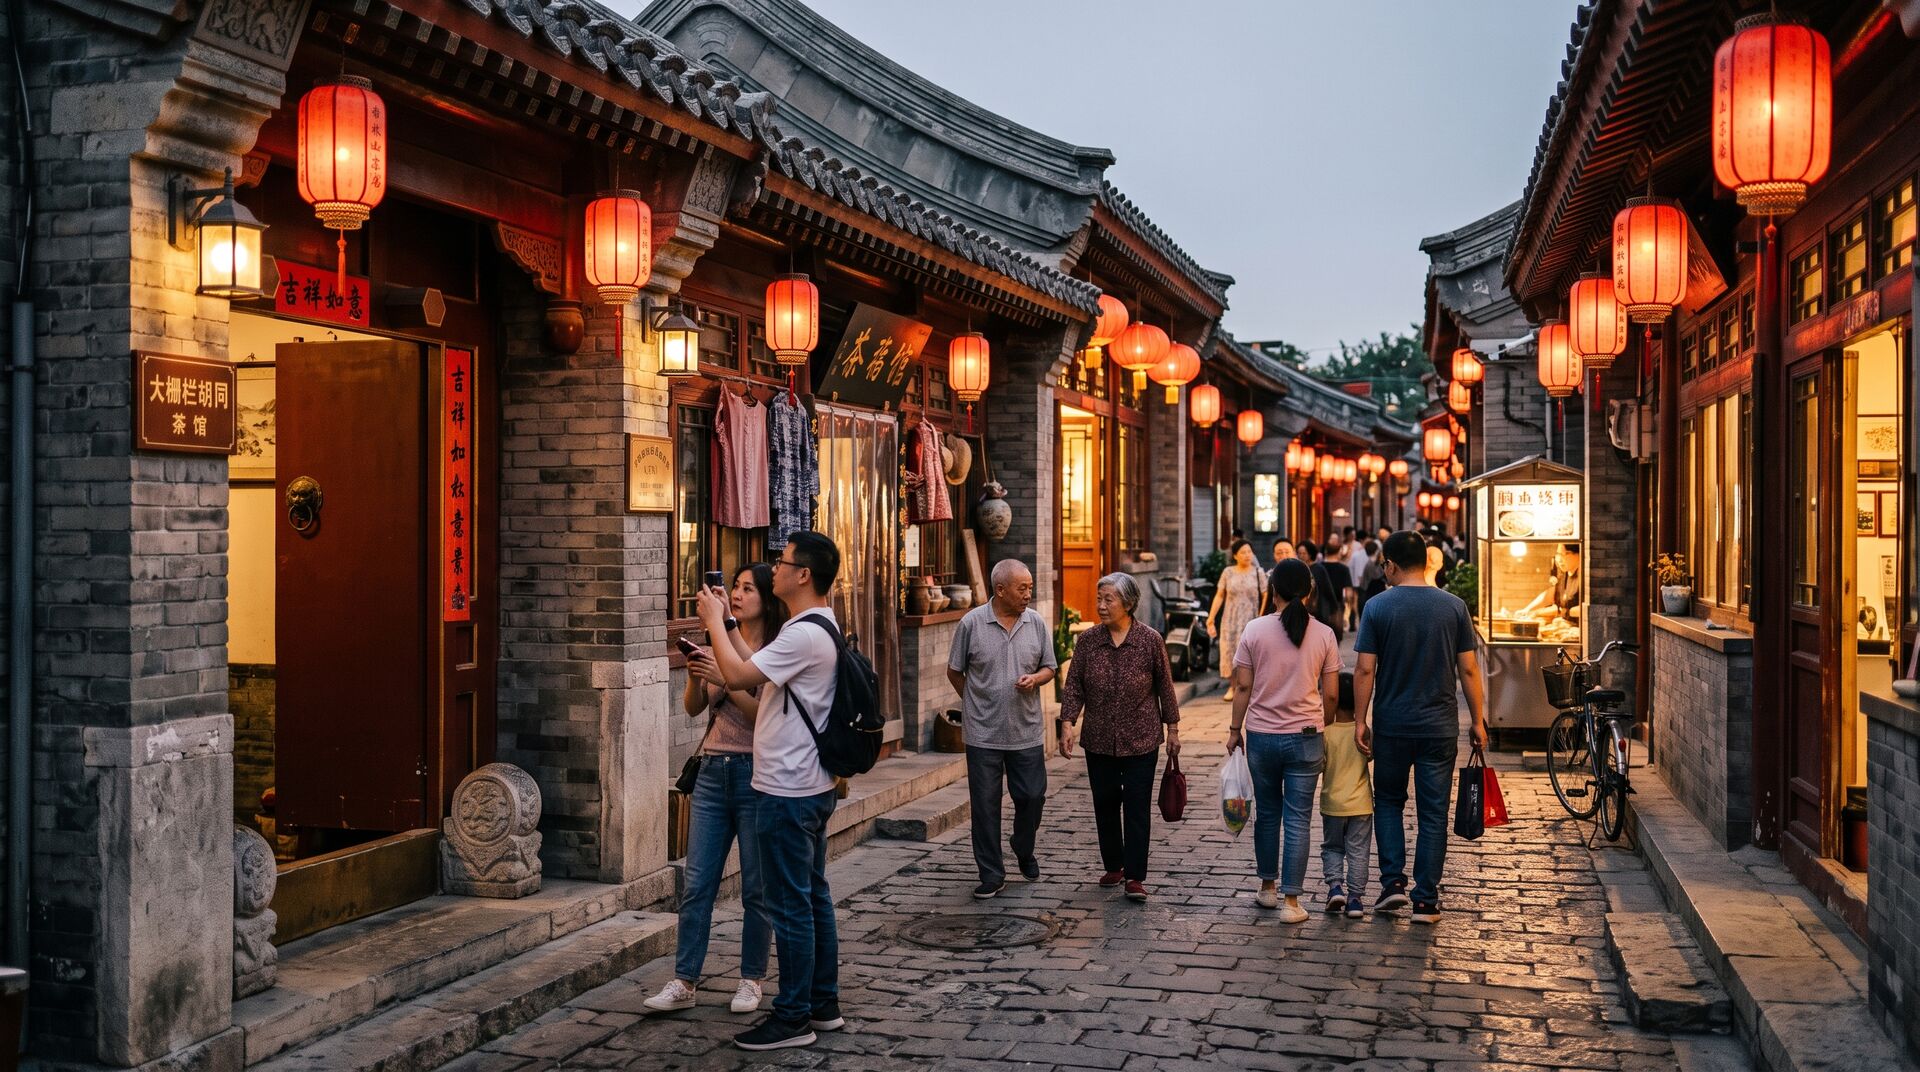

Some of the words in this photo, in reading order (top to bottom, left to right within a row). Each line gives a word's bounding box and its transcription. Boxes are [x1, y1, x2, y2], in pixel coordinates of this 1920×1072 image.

[282, 272, 362, 320] 吉祥如意
[149, 374, 228, 409] 大栅栏胡同
[172, 413, 207, 437] 茶馆
